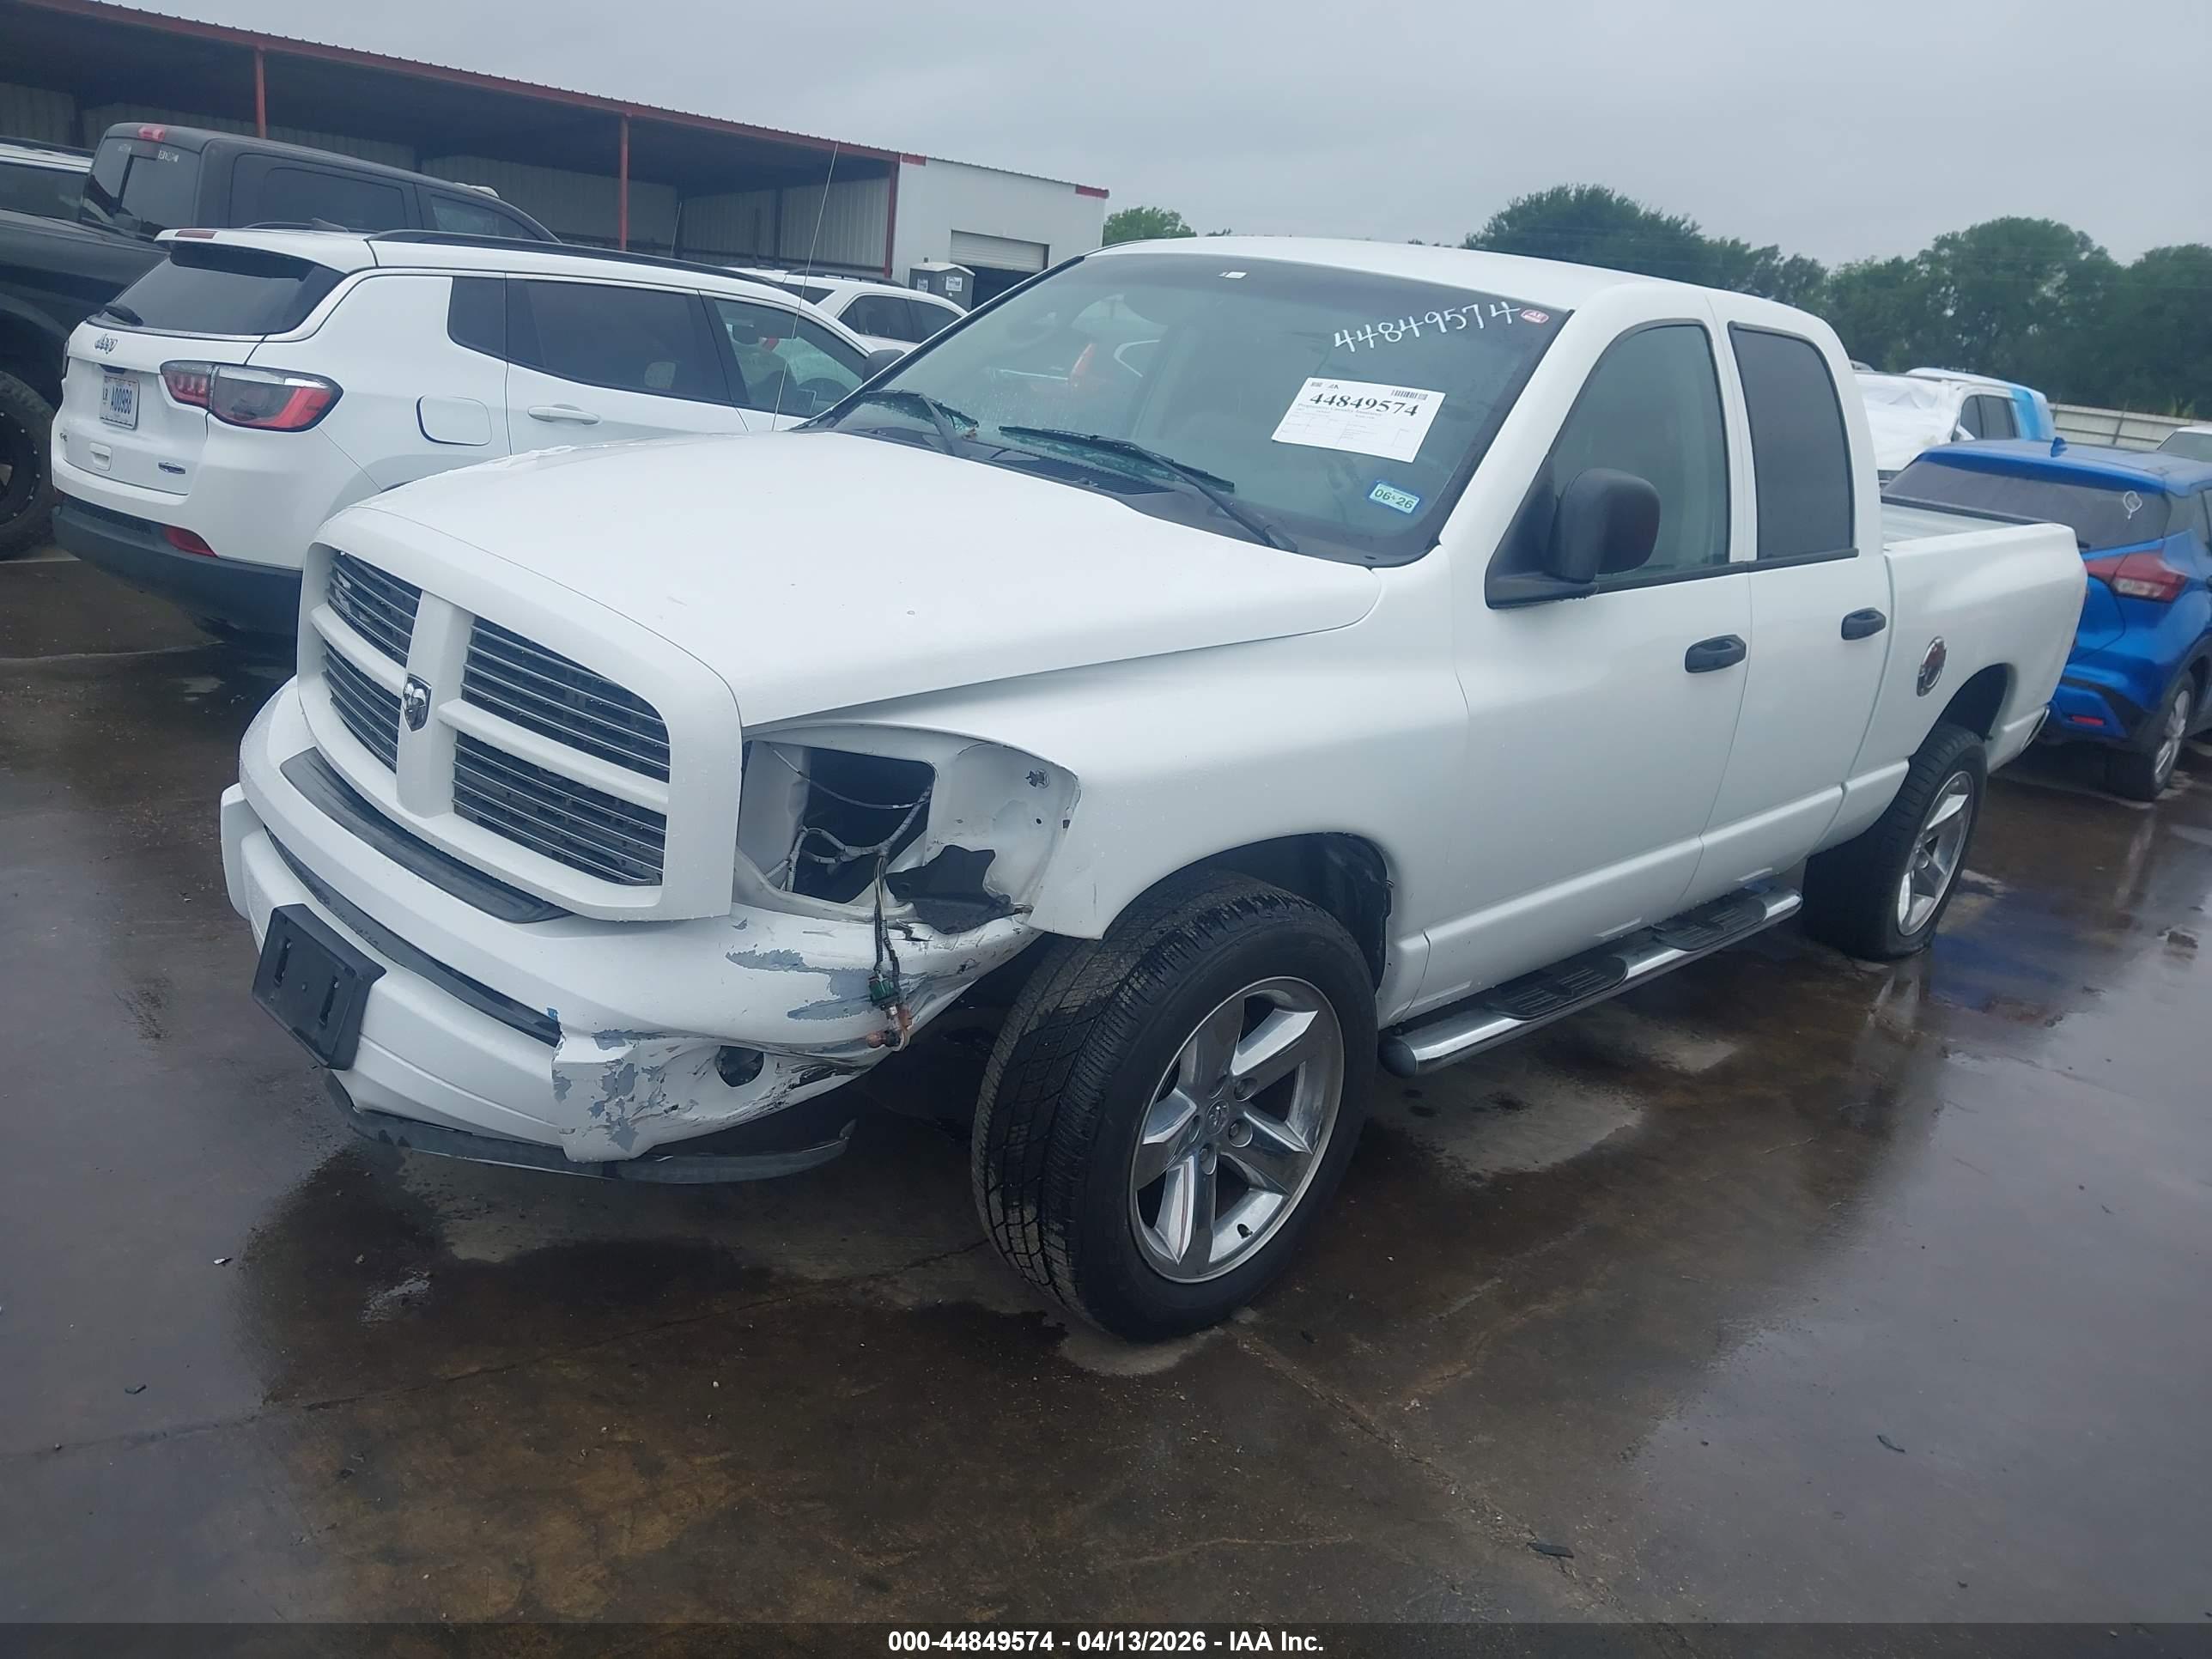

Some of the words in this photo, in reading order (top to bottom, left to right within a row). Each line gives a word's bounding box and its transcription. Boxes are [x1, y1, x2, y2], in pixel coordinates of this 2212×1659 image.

[1334, 301, 1520, 352] 44849574
[1310, 392, 1419, 416] 44849574
[1395, 496, 1414, 509] 26
